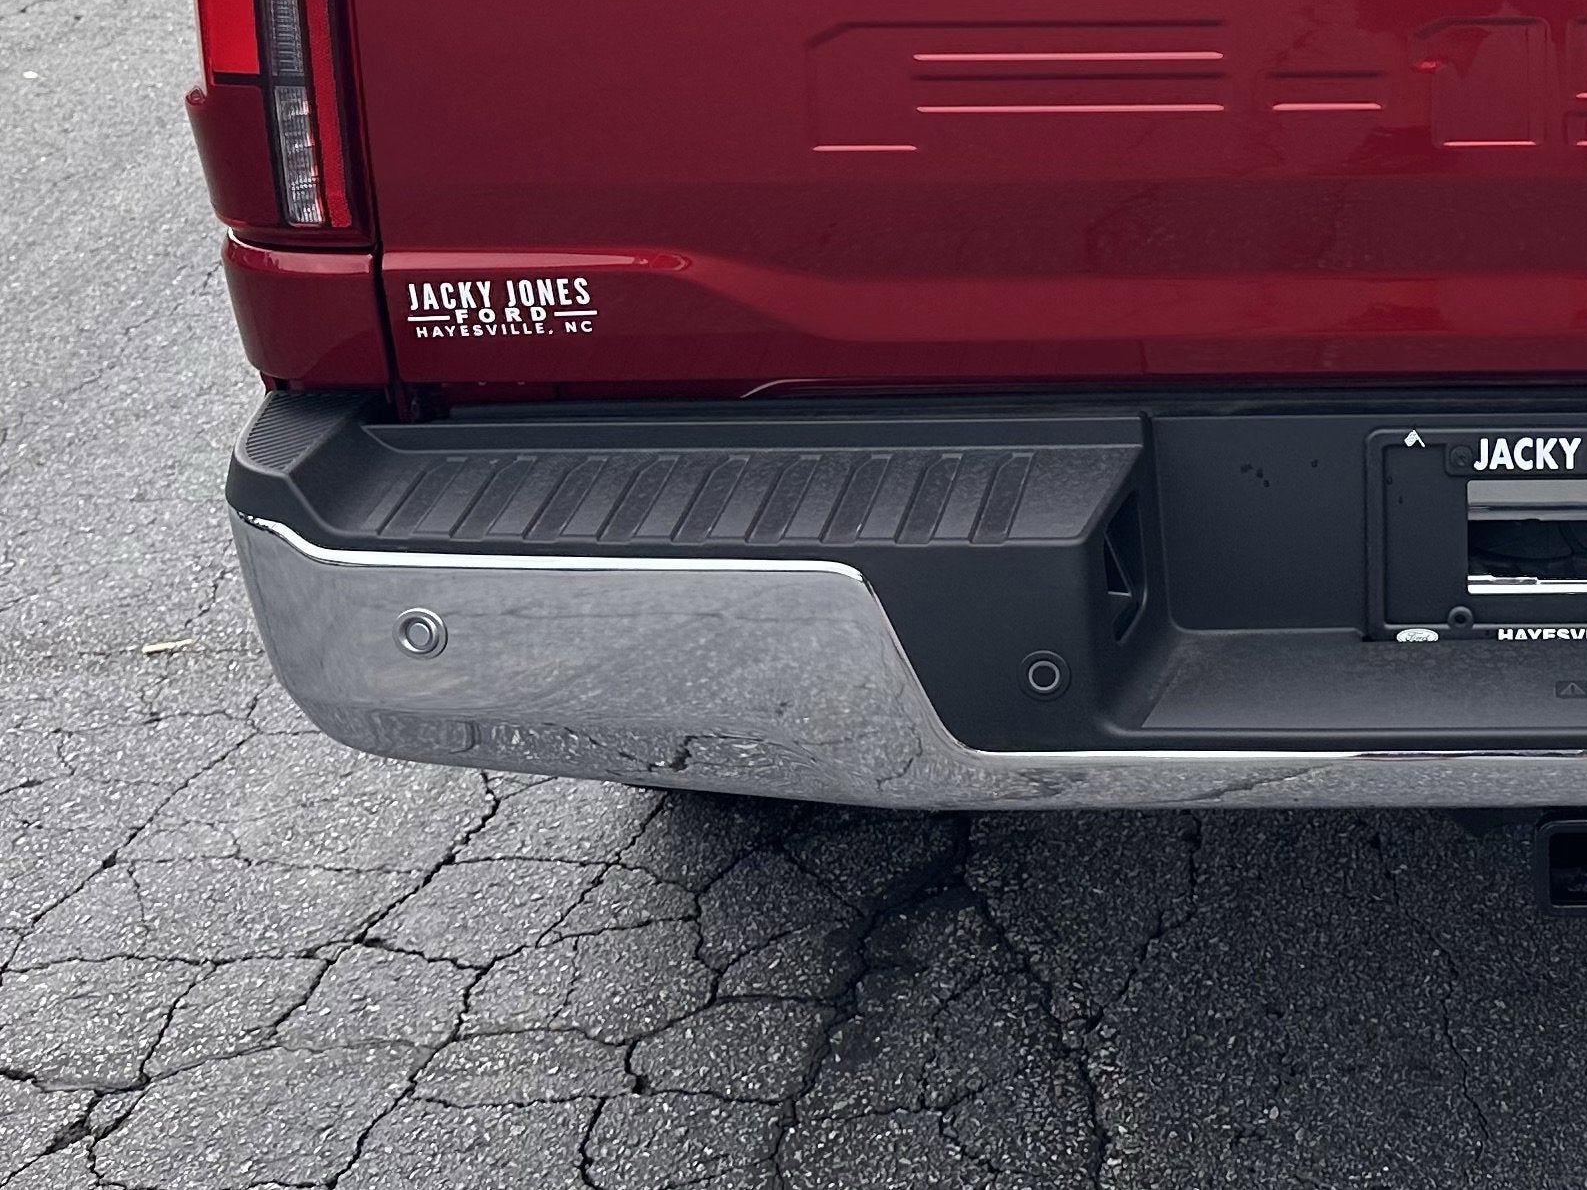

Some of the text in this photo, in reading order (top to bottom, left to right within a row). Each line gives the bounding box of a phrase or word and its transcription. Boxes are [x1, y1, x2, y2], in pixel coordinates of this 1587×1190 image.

[408, 277, 591, 311] JACKY JONES
[455, 306, 547, 324] FORD
[416, 320, 593, 338] HAYESVILLE, NC
[1473, 437, 1582, 471] JACKY
